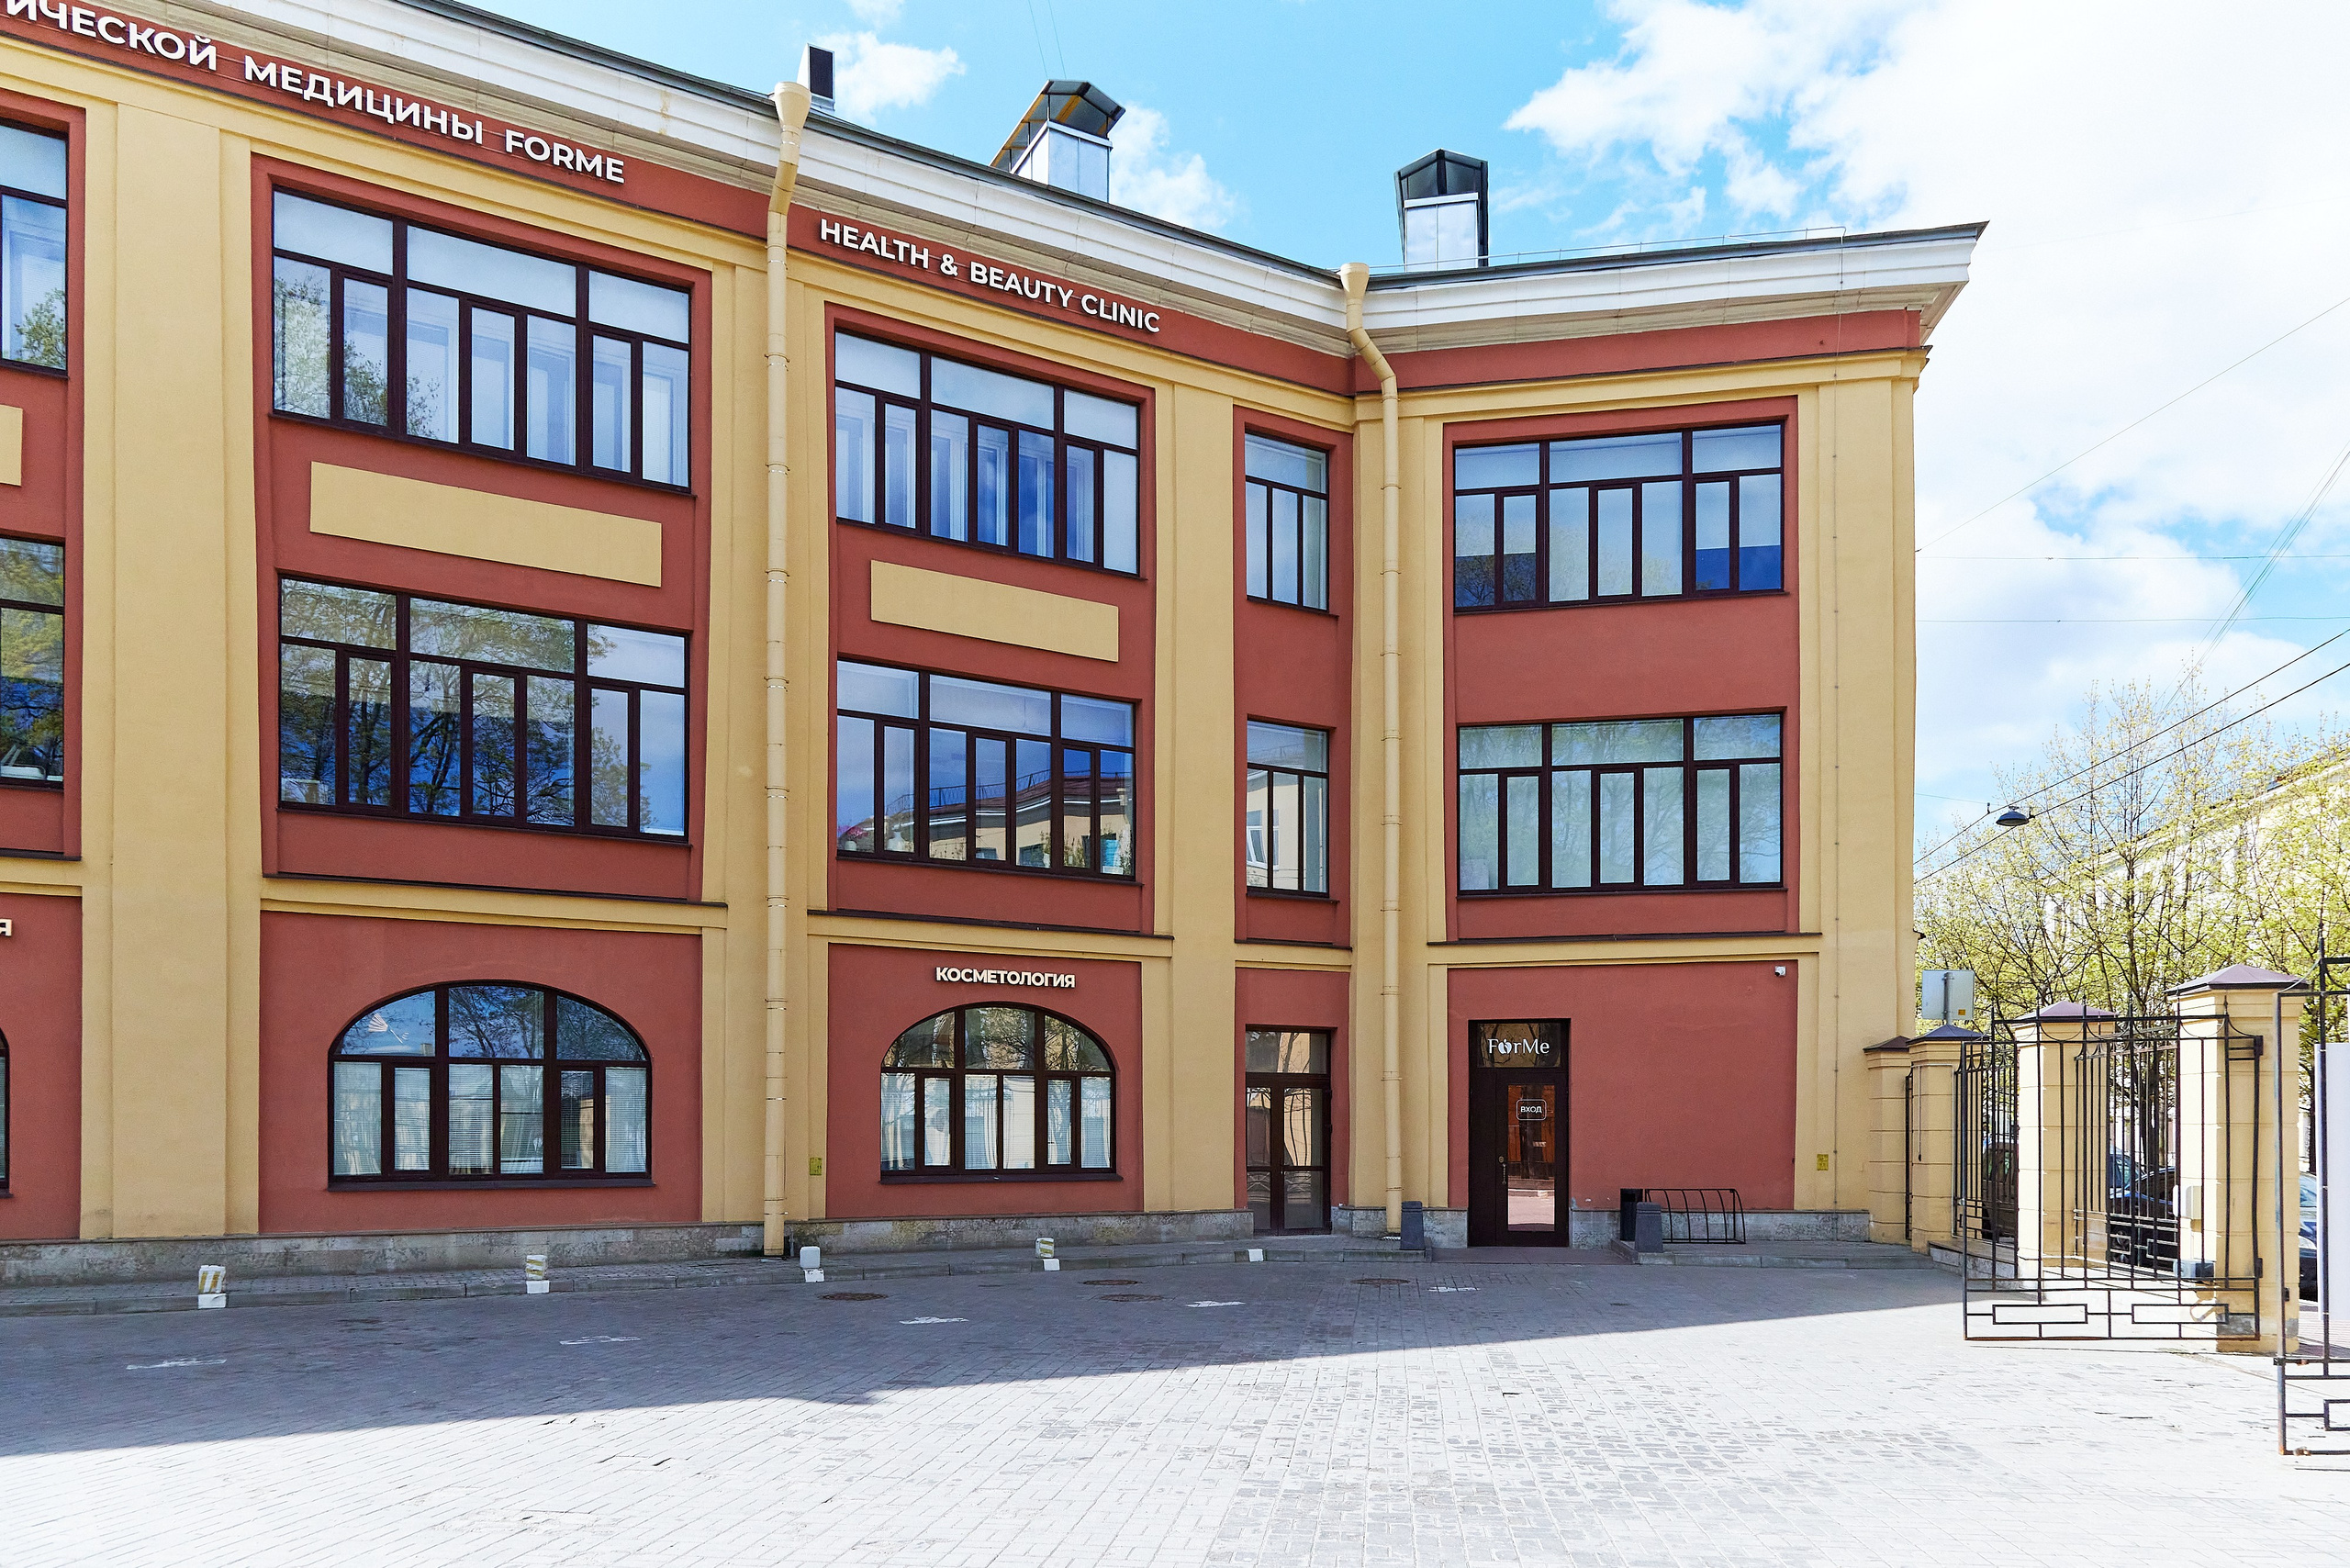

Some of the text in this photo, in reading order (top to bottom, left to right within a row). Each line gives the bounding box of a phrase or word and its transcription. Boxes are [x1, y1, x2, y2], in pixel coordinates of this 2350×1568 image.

[244, 55, 483, 144] МЕДИЦИНЫ
[506, 129, 624, 184] FORME
[820, 218, 1160, 333] HEALTH & BEAUTY CLINIC
[935, 967, 1076, 988] КОСМЕТОЛОГИЯ
[1487, 1038, 1550, 1055] ForMe
